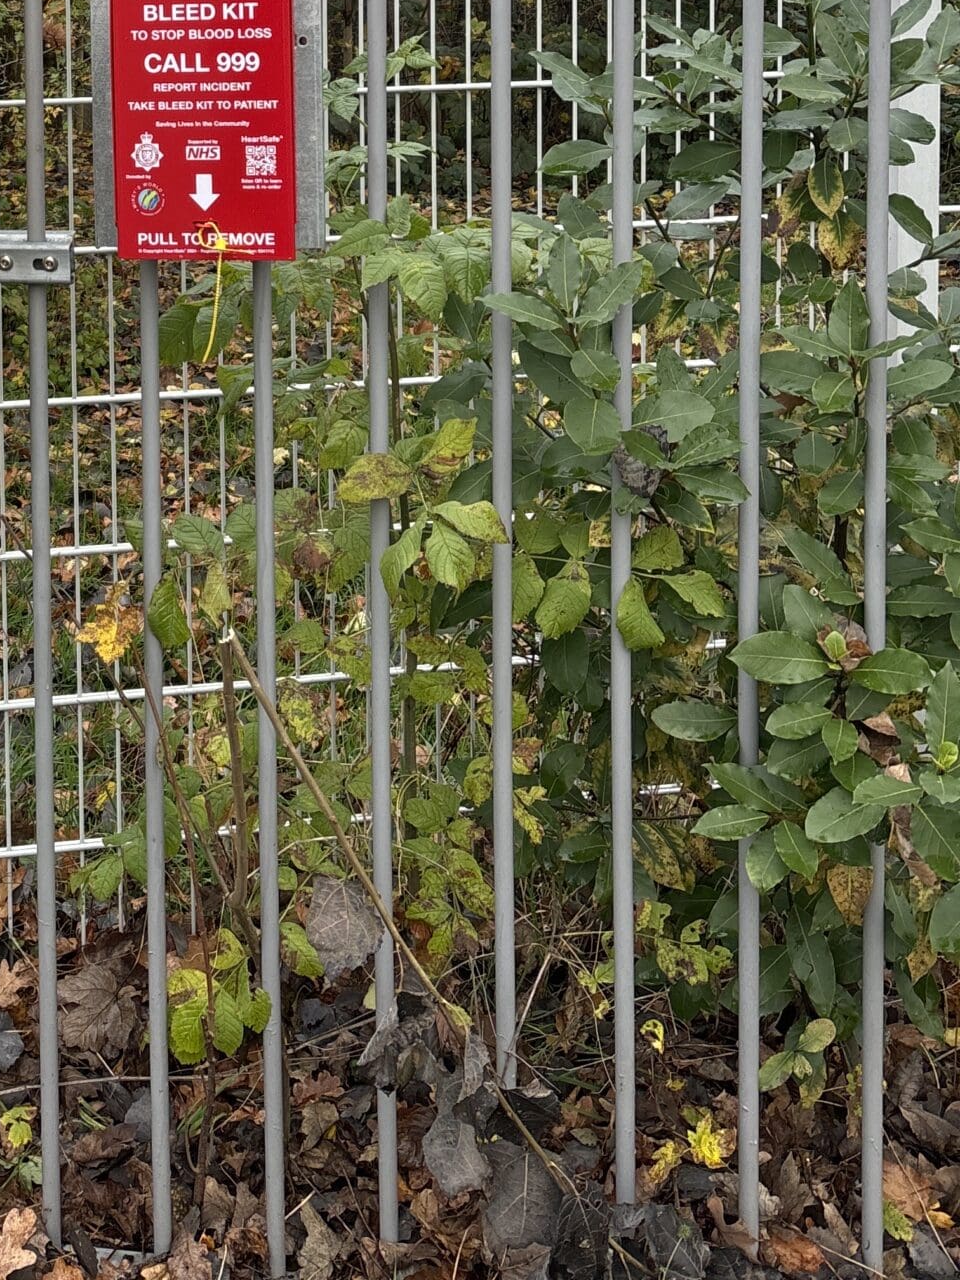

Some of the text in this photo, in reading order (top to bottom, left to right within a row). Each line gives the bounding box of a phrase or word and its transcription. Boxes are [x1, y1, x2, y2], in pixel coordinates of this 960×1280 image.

[143, 2, 259, 22] BLEED KIT
[130, 28, 272, 41] TO STOP BLOOD LOSS
[144, 52, 260, 73] CALL 999
[153, 82, 252, 92] REPORT INCIDENT
[127, 100, 279, 111] TAKE BLEED KIT TO PATIENT
[213, 120, 250, 128] Community
[187, 147, 218, 159] NHS
[137, 232, 178, 245] PULL
